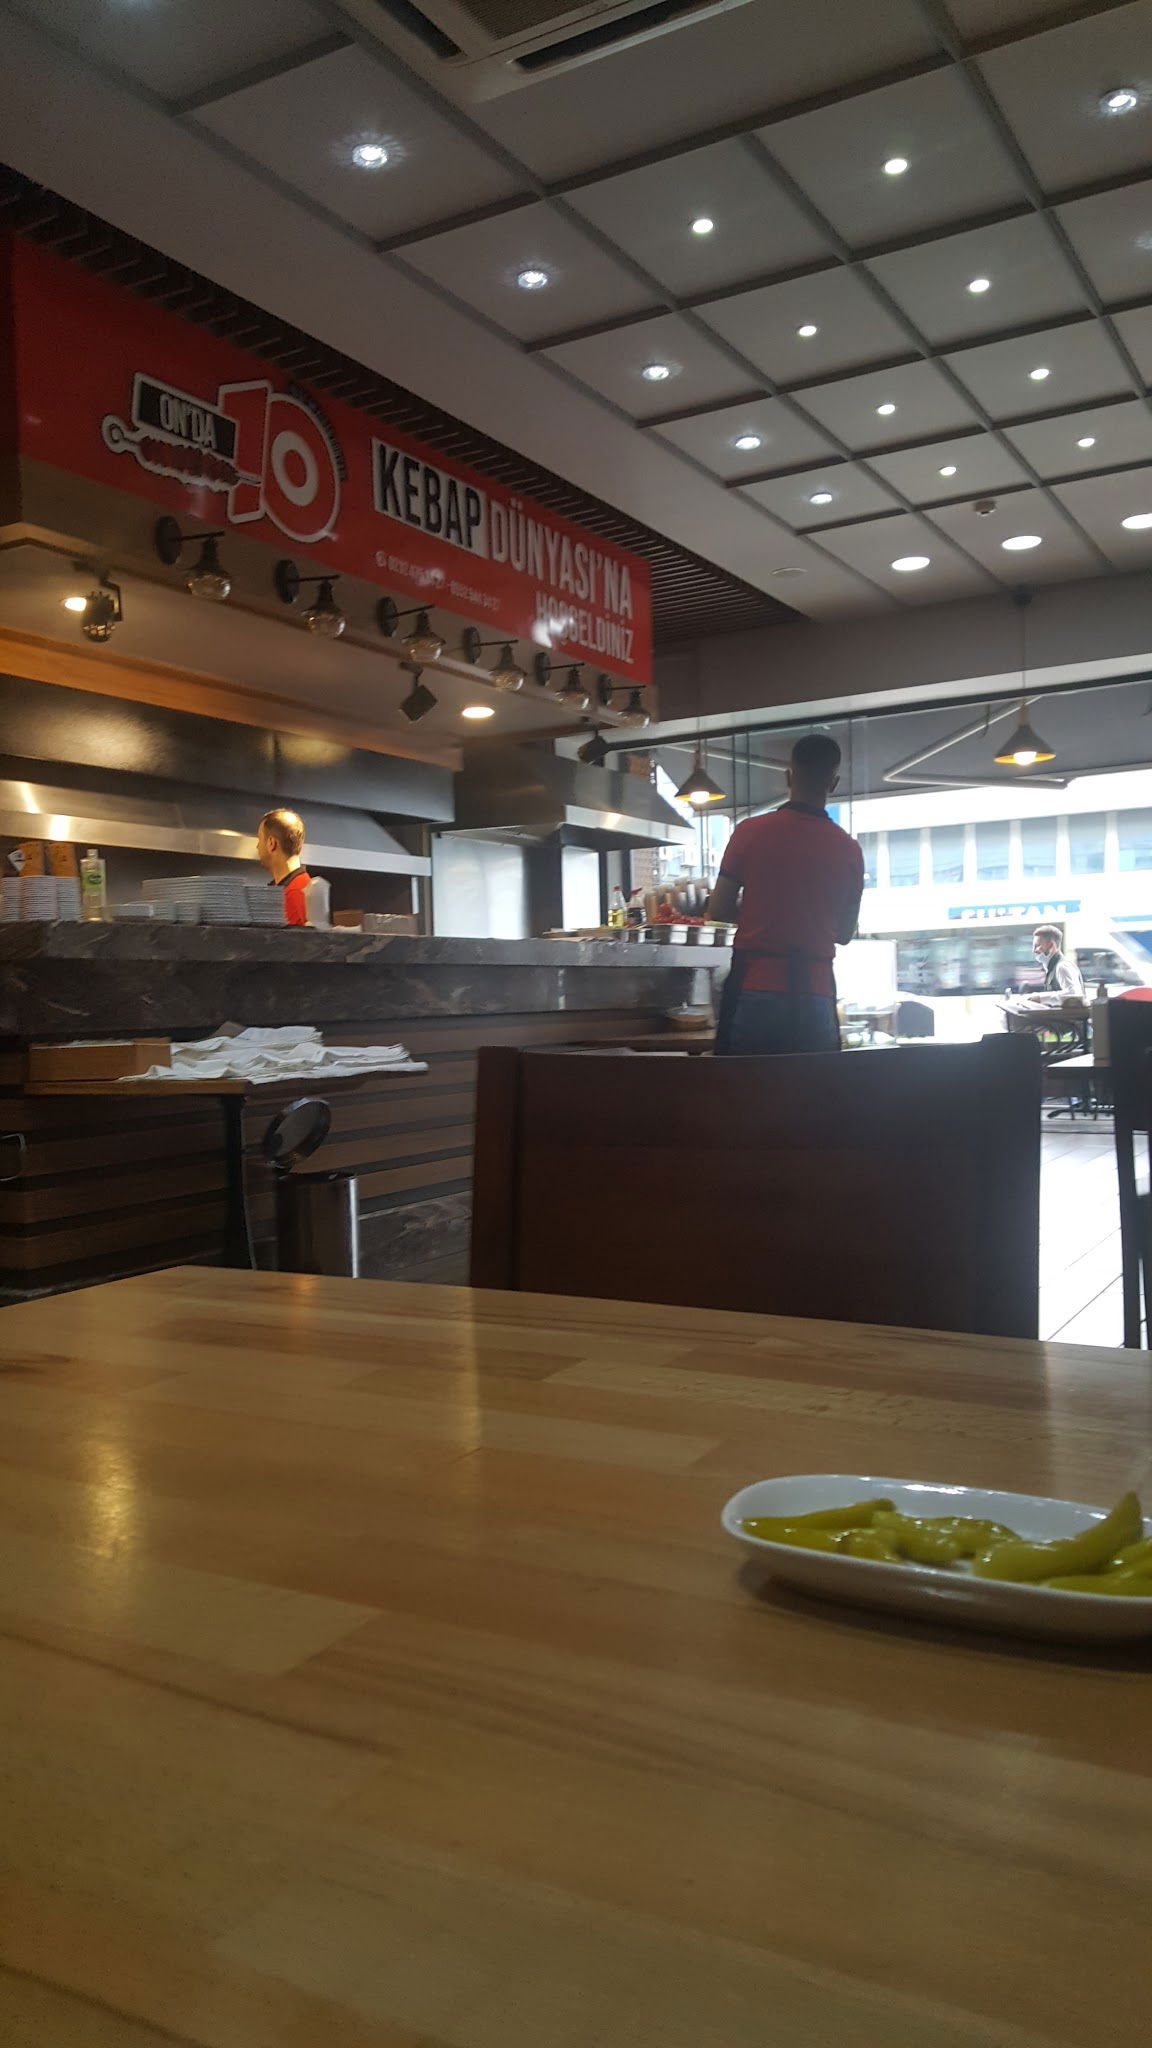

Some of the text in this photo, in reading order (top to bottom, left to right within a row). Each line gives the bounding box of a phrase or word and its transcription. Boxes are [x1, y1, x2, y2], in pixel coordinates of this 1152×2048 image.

[159, 393, 217, 449] ON'DA
[218, 380, 341, 543] 10
[379, 444, 633, 619] KEBAP DÜNYASI'NA
[534, 590, 635, 665] HOŞGELDİNİZ
